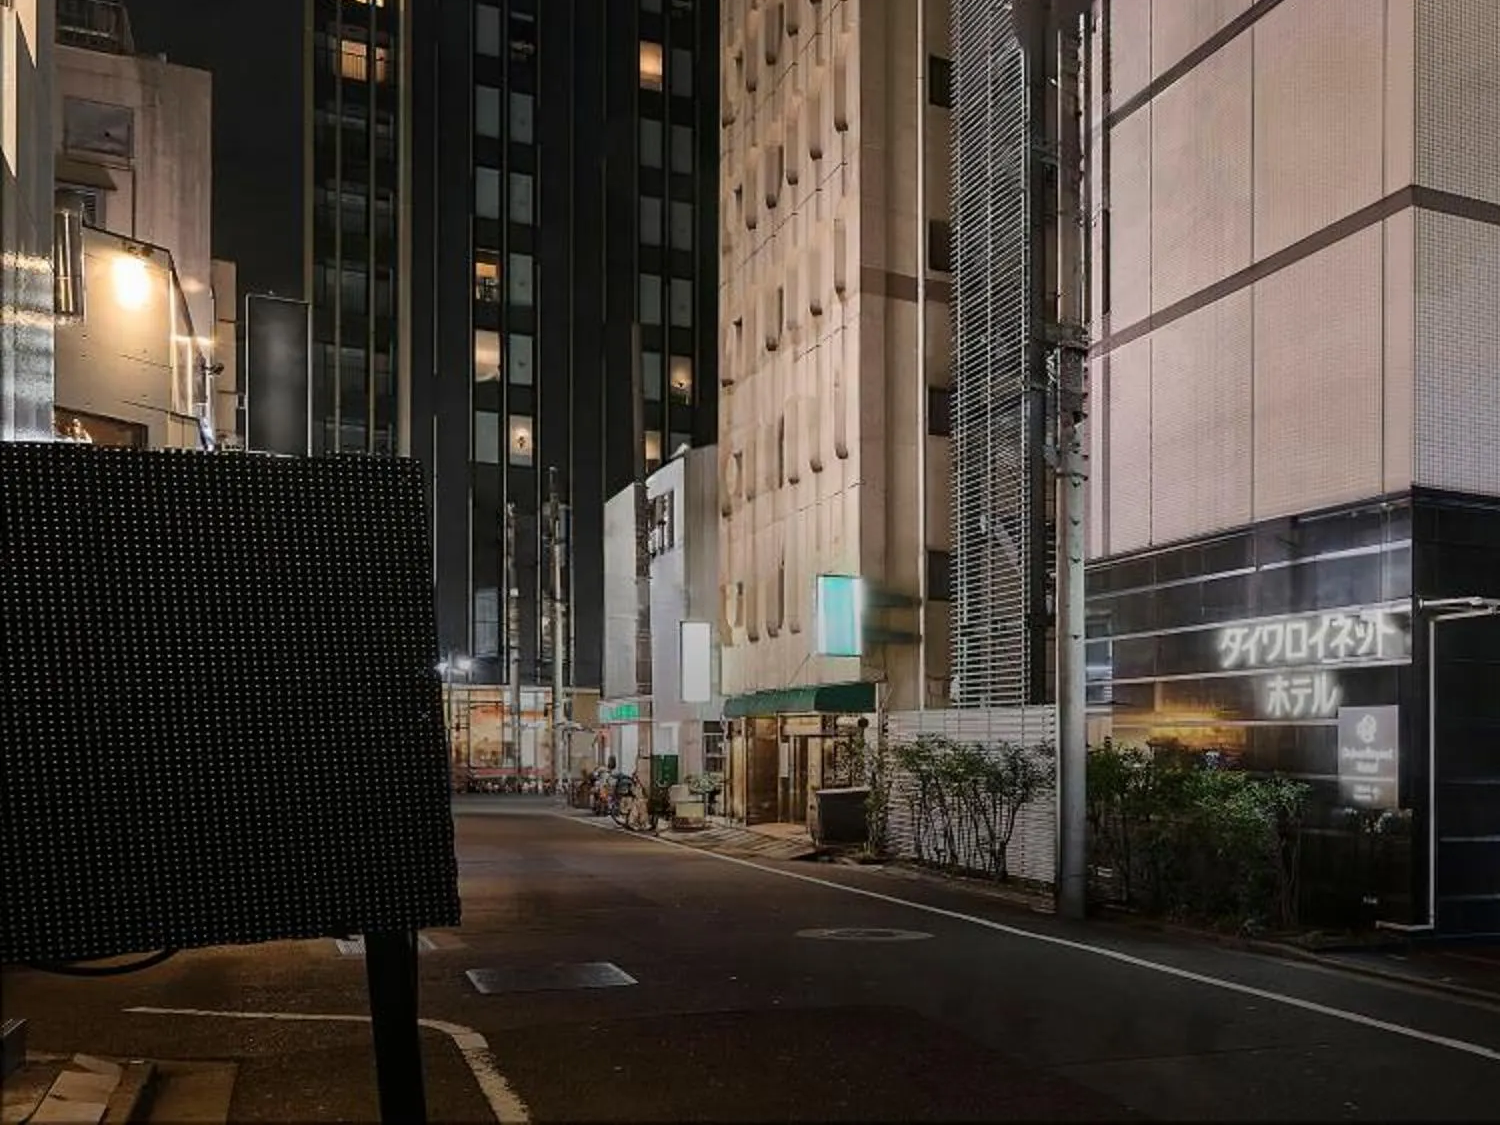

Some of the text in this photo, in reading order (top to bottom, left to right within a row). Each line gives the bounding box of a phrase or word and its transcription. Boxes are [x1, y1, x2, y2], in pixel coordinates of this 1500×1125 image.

[1219, 609, 1396, 668] ダイワロイネット
[1266, 672, 1340, 717] ホテル
